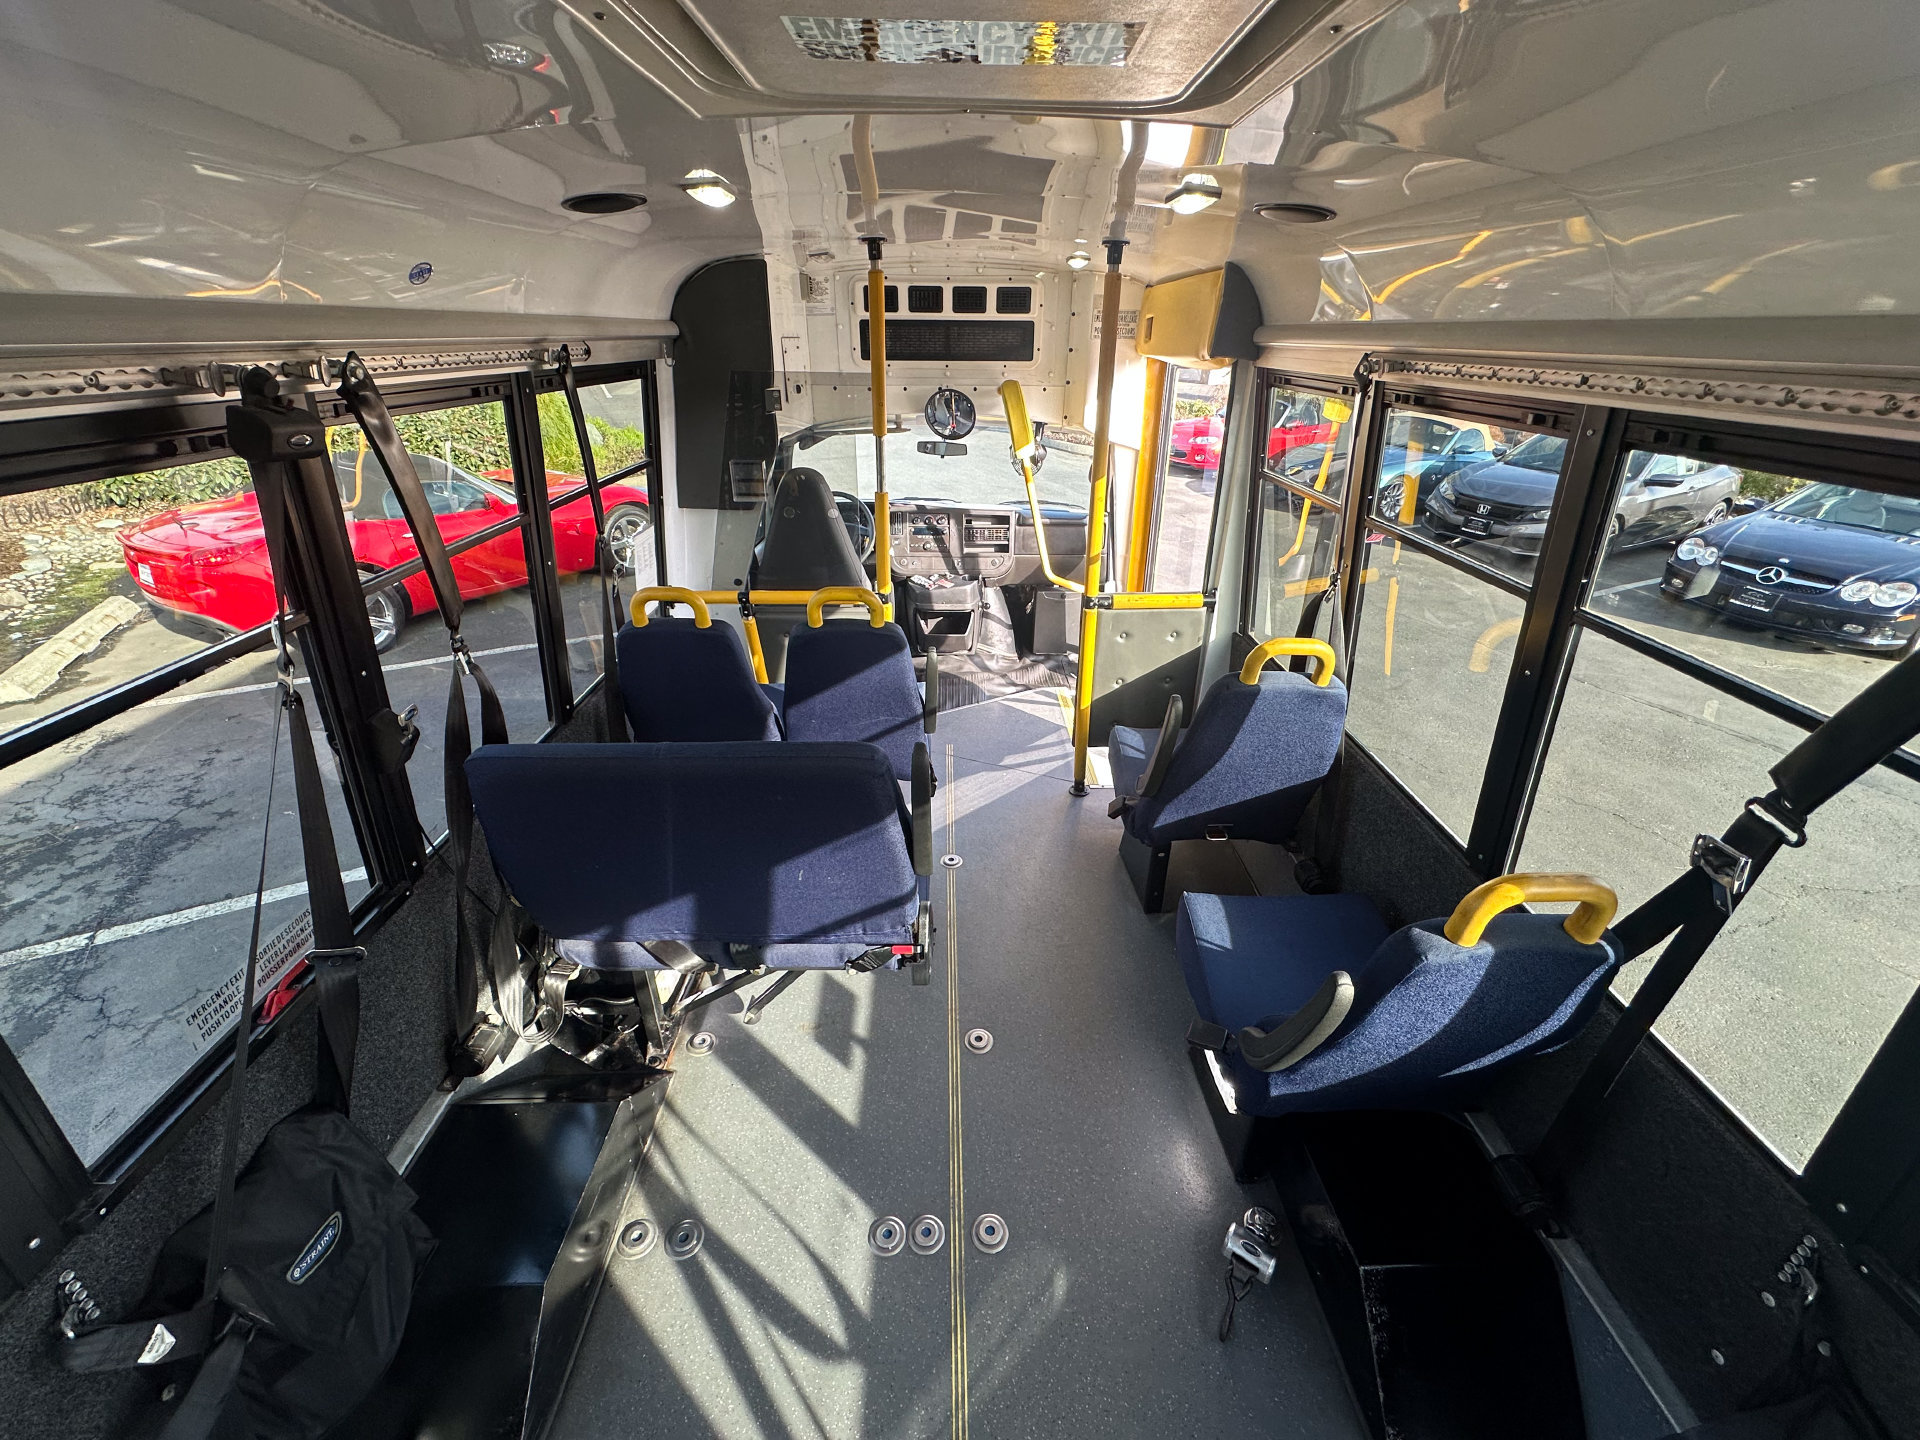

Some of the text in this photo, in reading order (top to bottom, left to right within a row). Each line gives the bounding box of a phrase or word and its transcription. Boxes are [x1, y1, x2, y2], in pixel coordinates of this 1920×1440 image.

[1044, 22, 1129, 46] XIT
[256, 937, 277, 963] SORTIE
[285, 908, 311, 937] SECOURS
[257, 957, 286, 987] POUSSER
[285, 942, 301, 962] POUR
[260, 951, 280, 973] LEVER
[185, 967, 245, 1027] EMERGENCY EXIT
[197, 1010, 214, 1031] LIFT
[201, 1020, 222, 1042] PUSH
